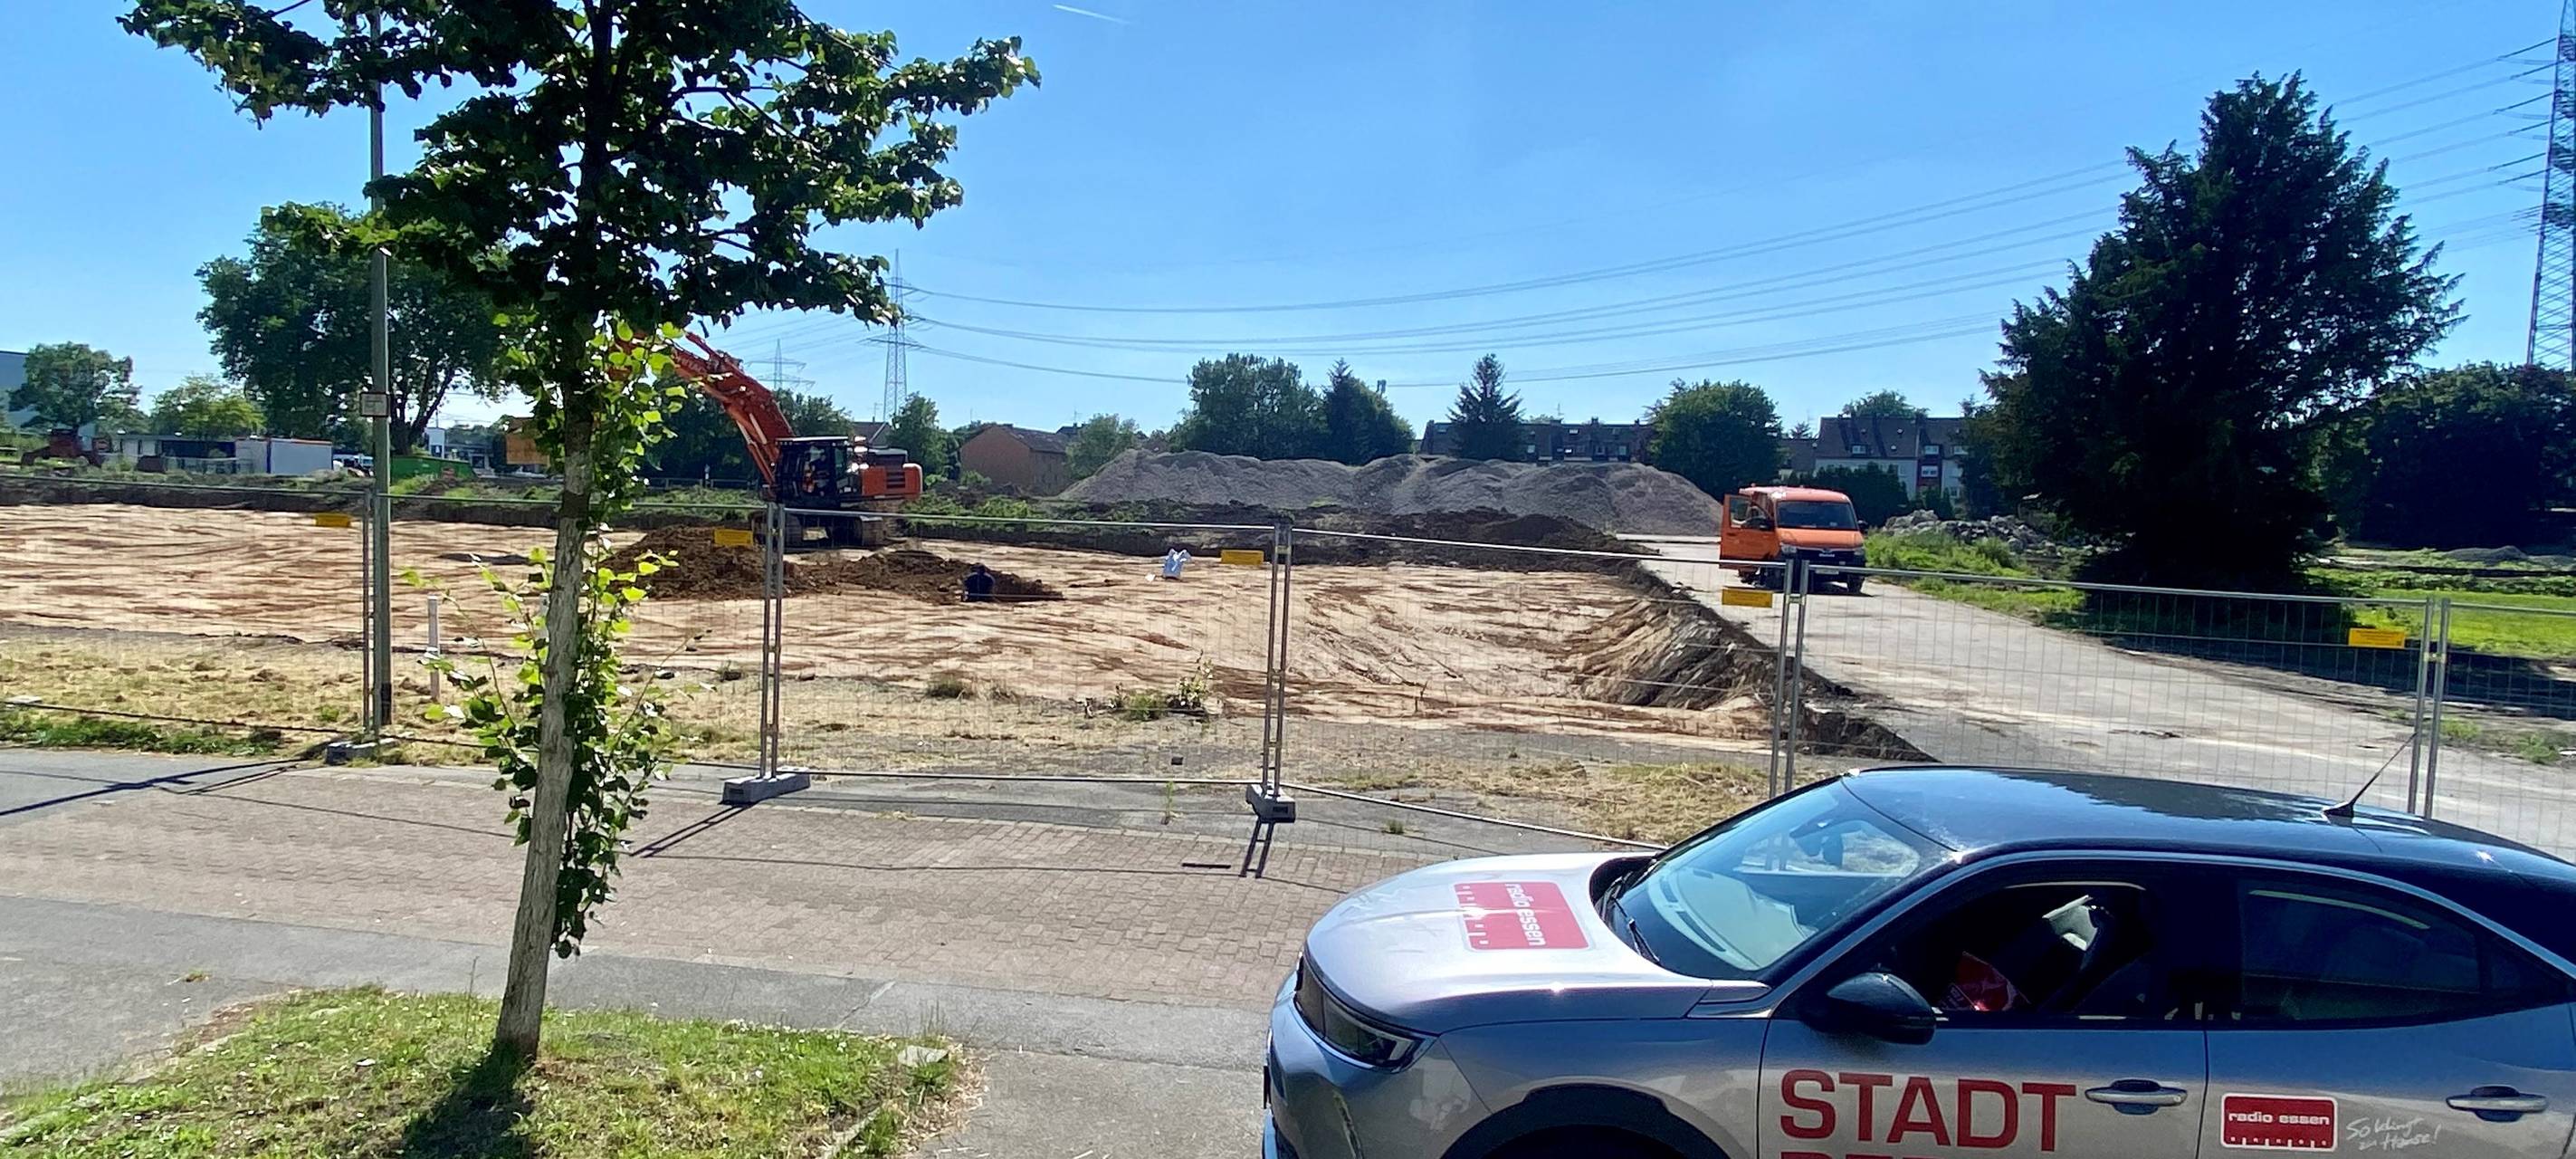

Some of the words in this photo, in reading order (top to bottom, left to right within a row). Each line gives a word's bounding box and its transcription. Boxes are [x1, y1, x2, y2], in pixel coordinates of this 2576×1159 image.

[1505, 883, 1534, 907] radio
[1516, 908, 1546, 946] essen
[1780, 1069, 2076, 1152] STADT
[2228, 1112, 2273, 1124] radio
[2279, 1115, 2330, 1125] essen
[2345, 1117, 2371, 1140] So
